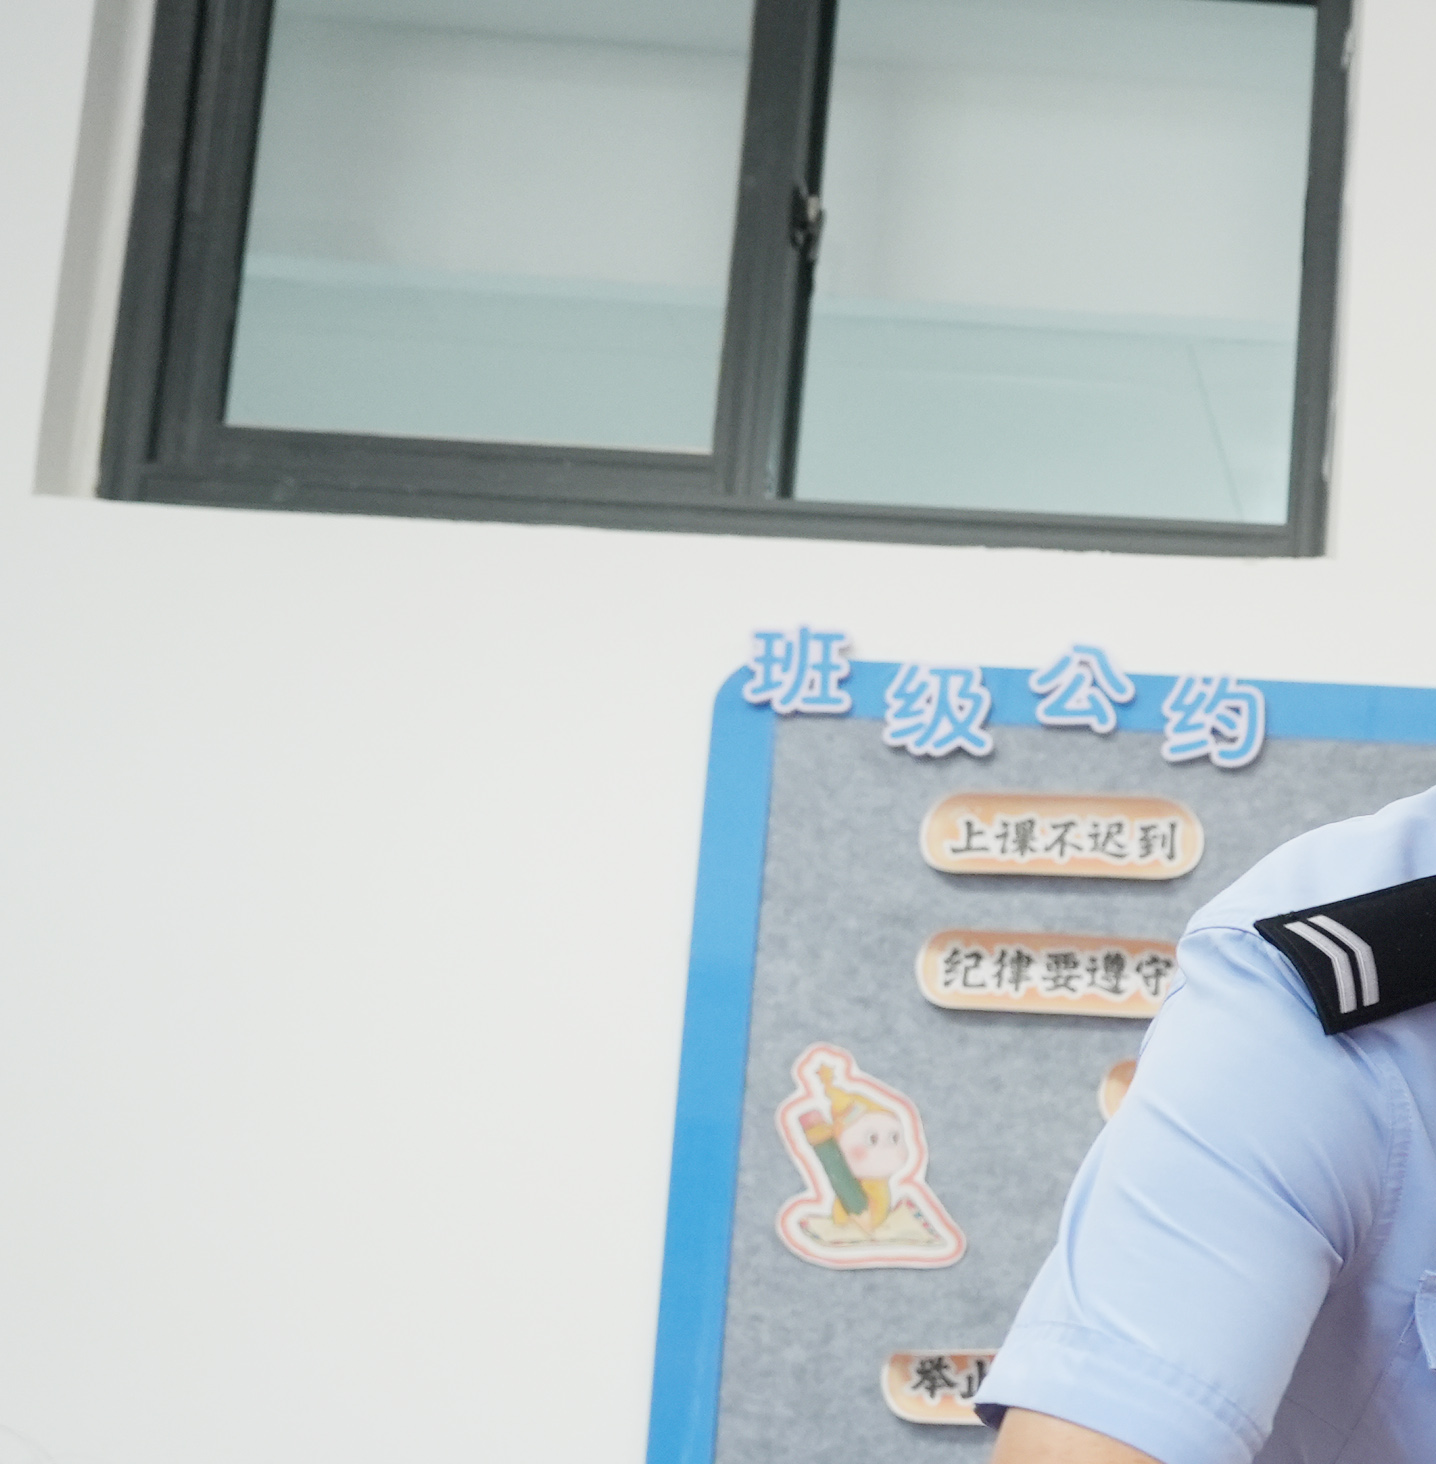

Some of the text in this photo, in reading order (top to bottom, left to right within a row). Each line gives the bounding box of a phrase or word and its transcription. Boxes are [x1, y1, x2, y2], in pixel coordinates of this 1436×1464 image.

[745, 624, 1263, 765] 班级公约
[950, 818, 1177, 861] 上课不迟到
[943, 948, 1174, 997] 纪律要遵守
